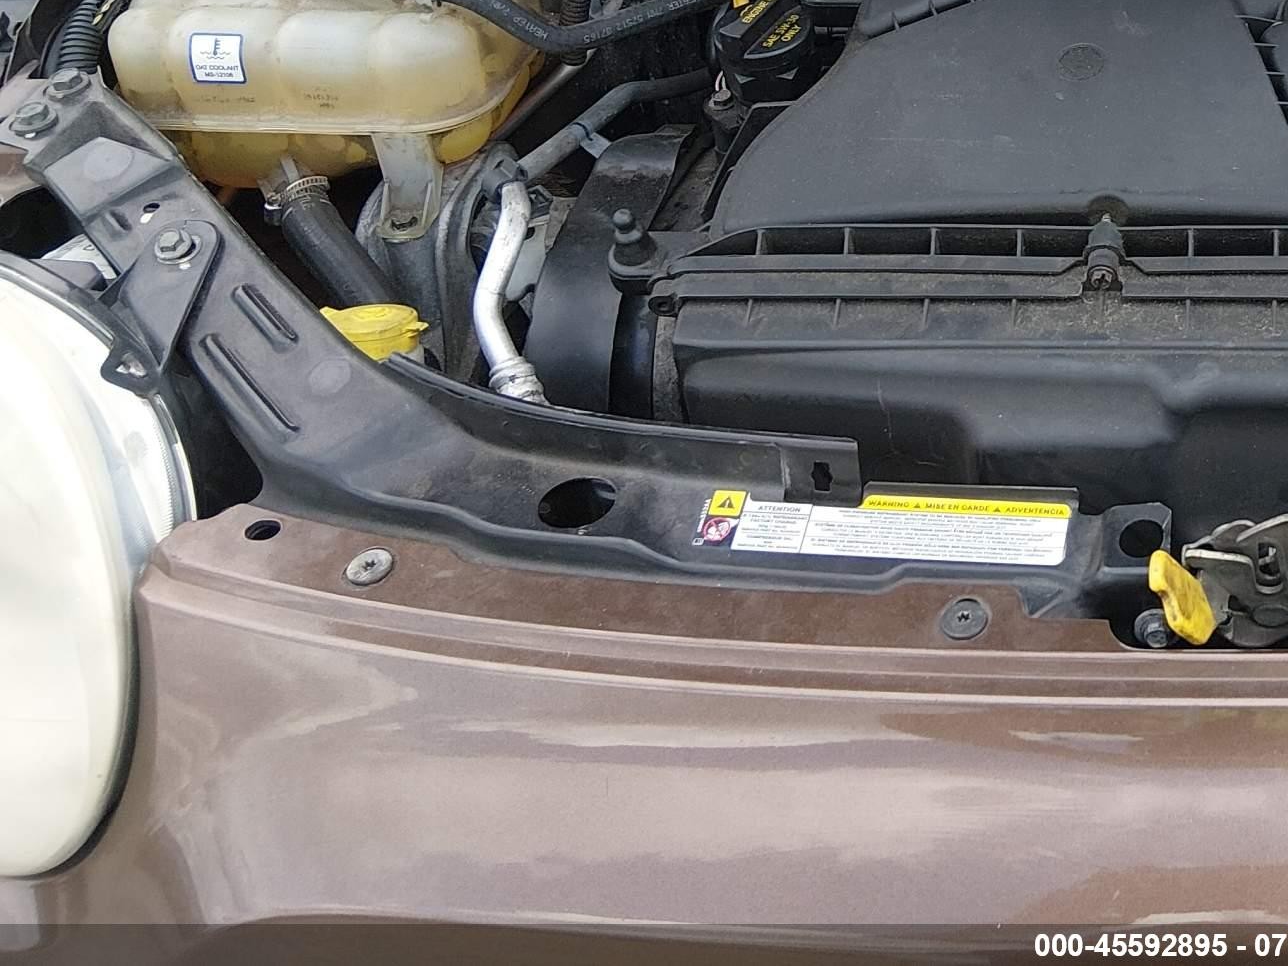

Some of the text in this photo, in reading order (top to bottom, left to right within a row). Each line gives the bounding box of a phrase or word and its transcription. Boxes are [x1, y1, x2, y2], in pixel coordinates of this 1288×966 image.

[742, 0, 769, 23] ENGINE
[762, 34, 780, 47] SAE
[781, 24, 801, 42] ONLY
[758, 505, 801, 513] ATTENTION
[868, 499, 909, 508] WARNING
[925, 502, 945, 510] MISE
[961, 504, 990, 512] GARDE
[1005, 507, 1065, 515] ADVERTENCIA
